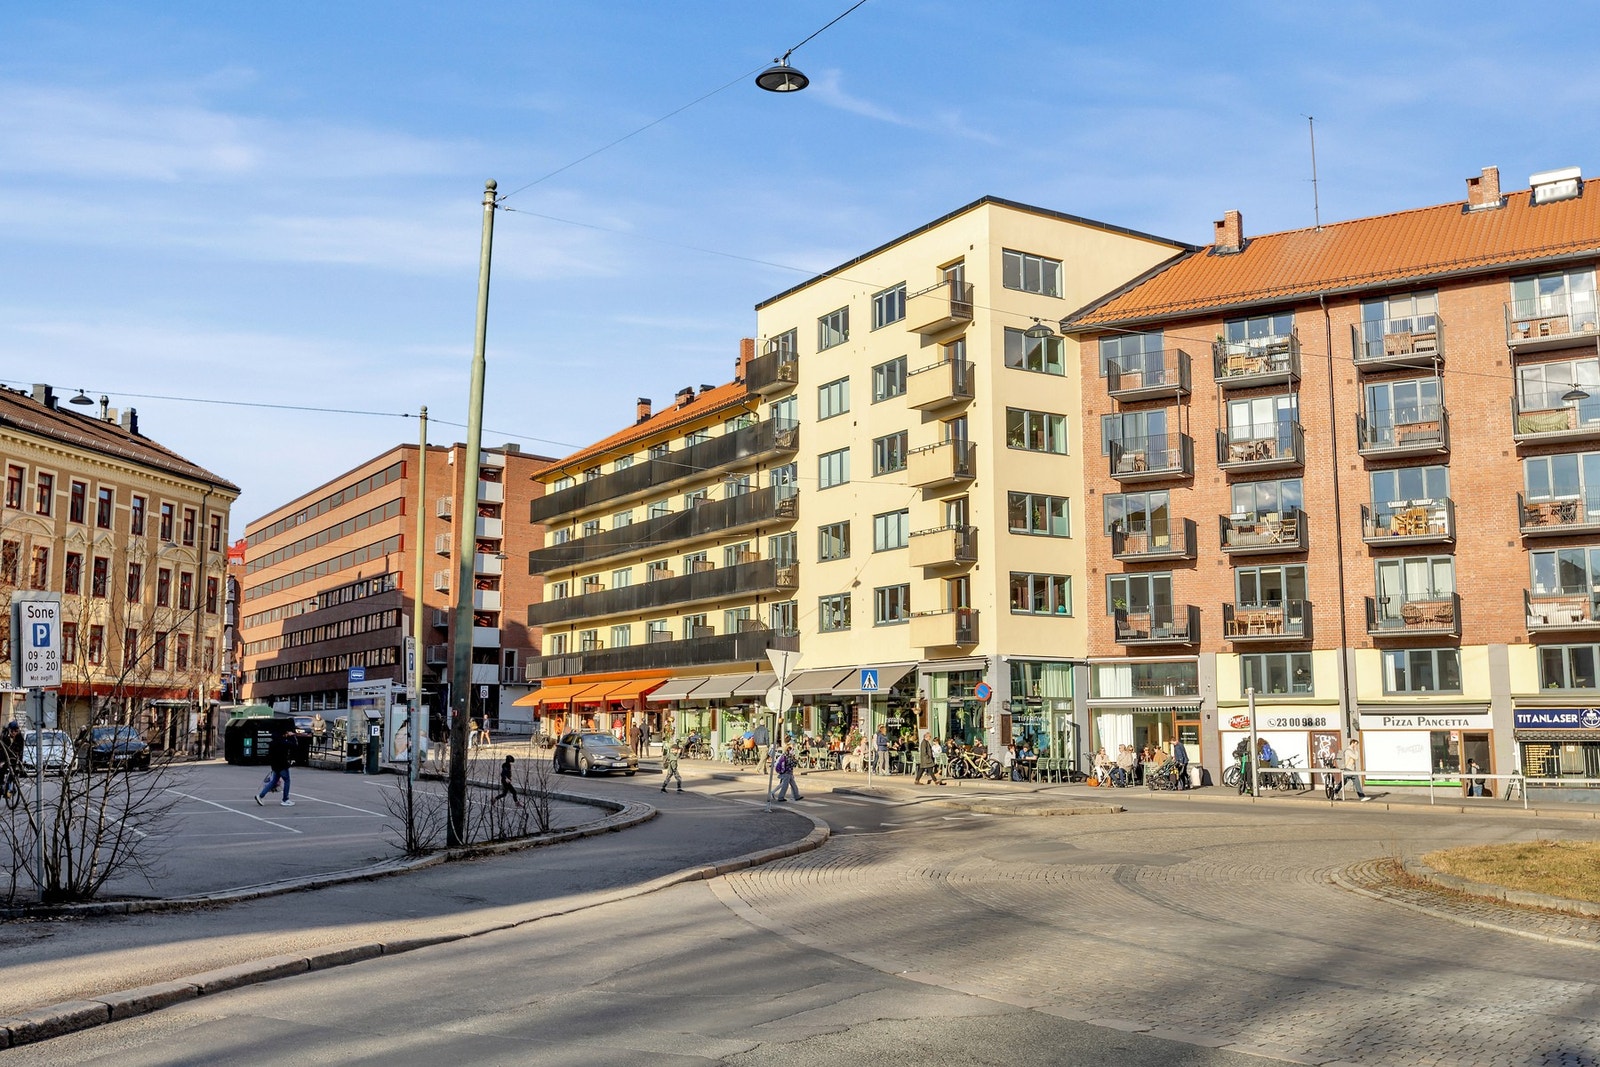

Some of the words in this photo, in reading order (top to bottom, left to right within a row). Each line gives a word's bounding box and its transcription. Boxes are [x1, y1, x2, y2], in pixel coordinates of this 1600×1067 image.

[27, 605, 55, 619] Sone
[36, 624, 48, 646] P
[28, 651, 38, 660] 09
[46, 650, 56, 660] 20
[25, 662, 38, 672] (09
[46, 661, 59, 671] 20)
[1276, 717, 1287, 727] 23
[1289, 717, 1300, 727] 00
[1302, 717, 1313, 727] 98
[1315, 717, 1327, 727] 88
[1417, 716, 1469, 726] PANCETTA
[1517, 714, 1578, 723] TITANLASER
